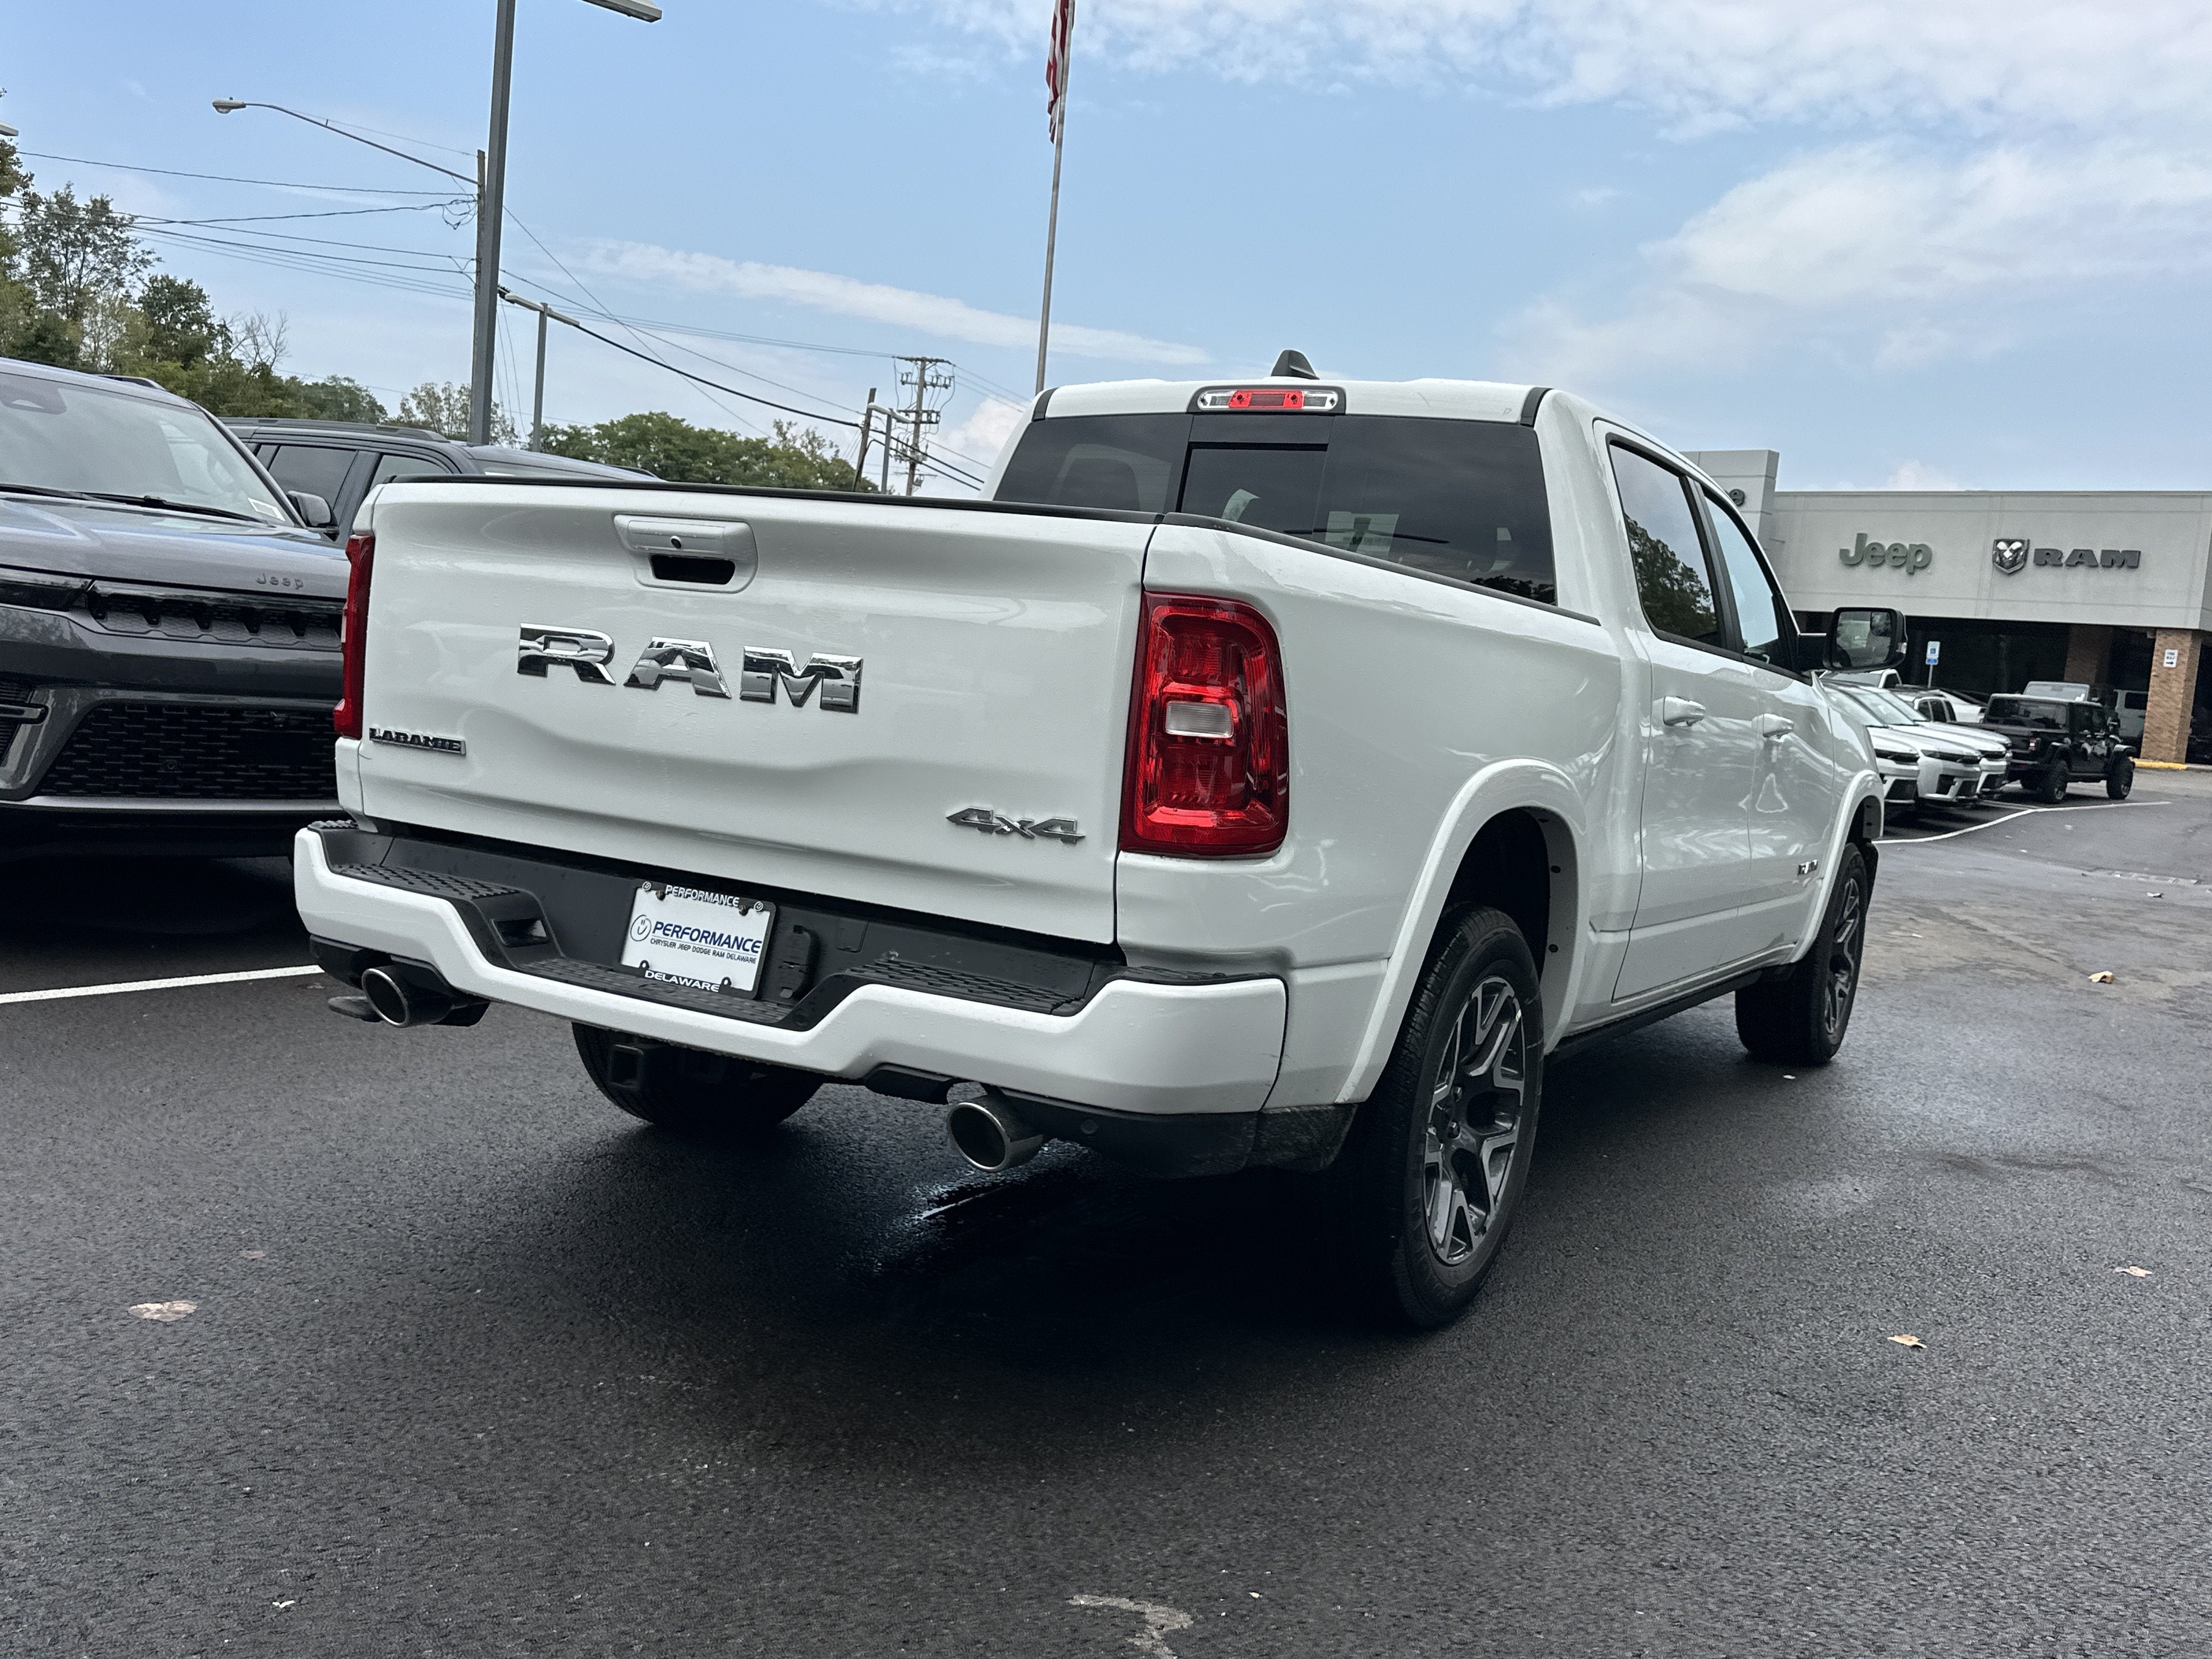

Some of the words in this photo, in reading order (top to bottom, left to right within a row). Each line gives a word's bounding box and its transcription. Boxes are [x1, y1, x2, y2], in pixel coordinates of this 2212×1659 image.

[1839, 533, 1932, 574] Jeep
[2033, 549, 2141, 569] RAM
[256, 573, 304, 590] Jeep
[517, 623, 863, 714] RAM
[369, 727, 466, 755] LARAMIE
[665, 884, 740, 907] PERFORMANCE
[652, 921, 762, 953] PERFORMANCE
[650, 938, 676, 949] CHRYSLER
[692, 946, 711, 956] DODGE
[712, 950, 725, 958] RAM
[726, 952, 757, 964] DELAWARE
[645, 970, 720, 992] DELAWARE
